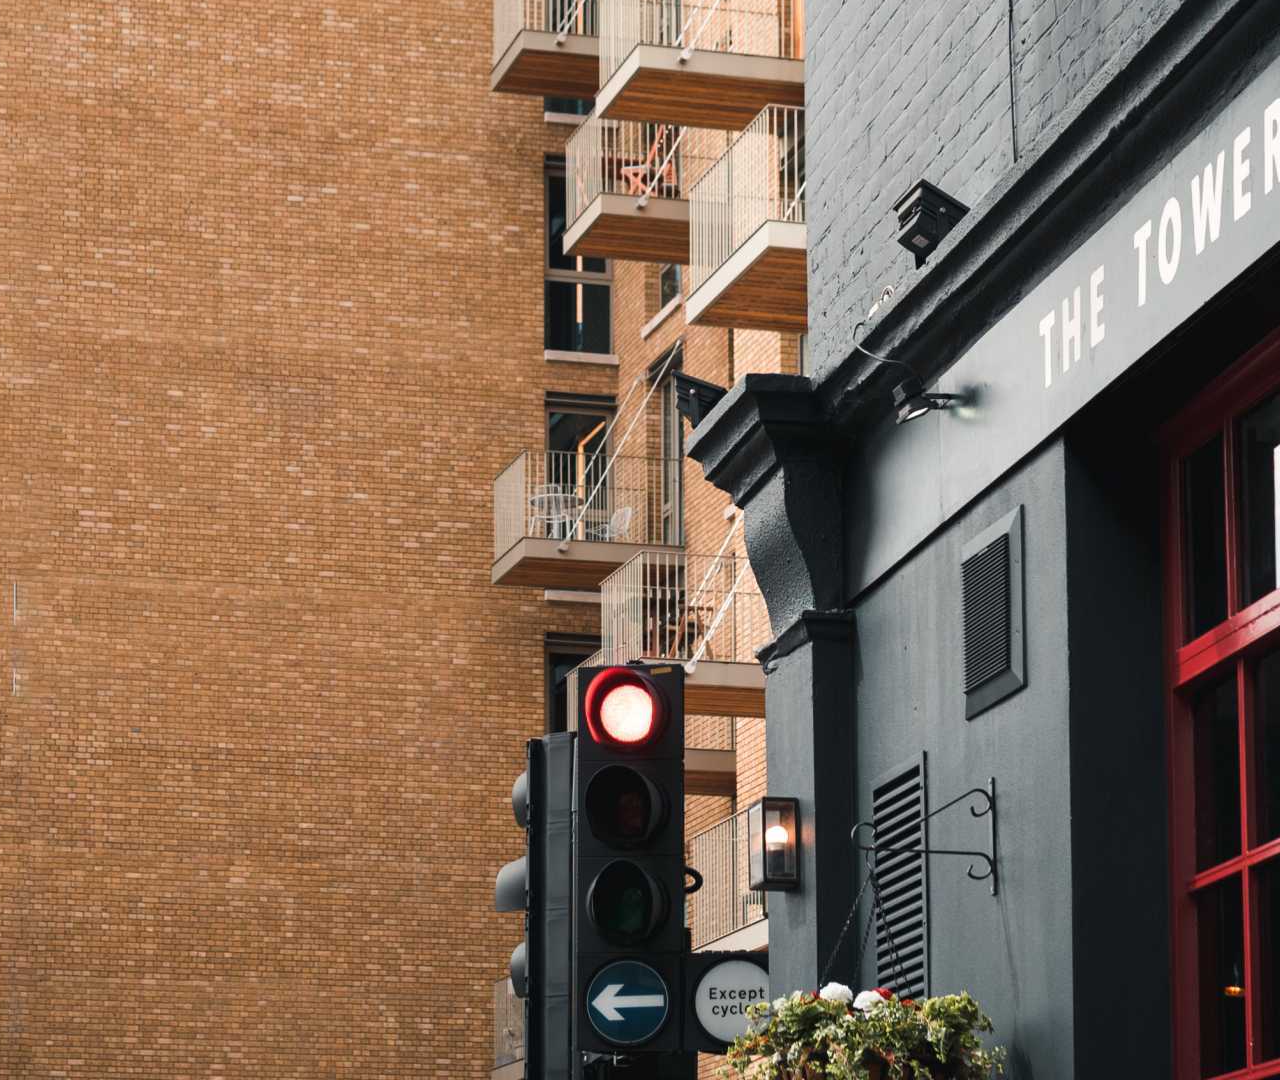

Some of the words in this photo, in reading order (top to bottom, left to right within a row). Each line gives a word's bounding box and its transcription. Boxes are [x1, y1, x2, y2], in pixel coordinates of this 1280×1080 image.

[1039, 264, 1105, 389] THE
[709, 987, 765, 1001] Except
[712, 1002, 761, 1018] cycl
